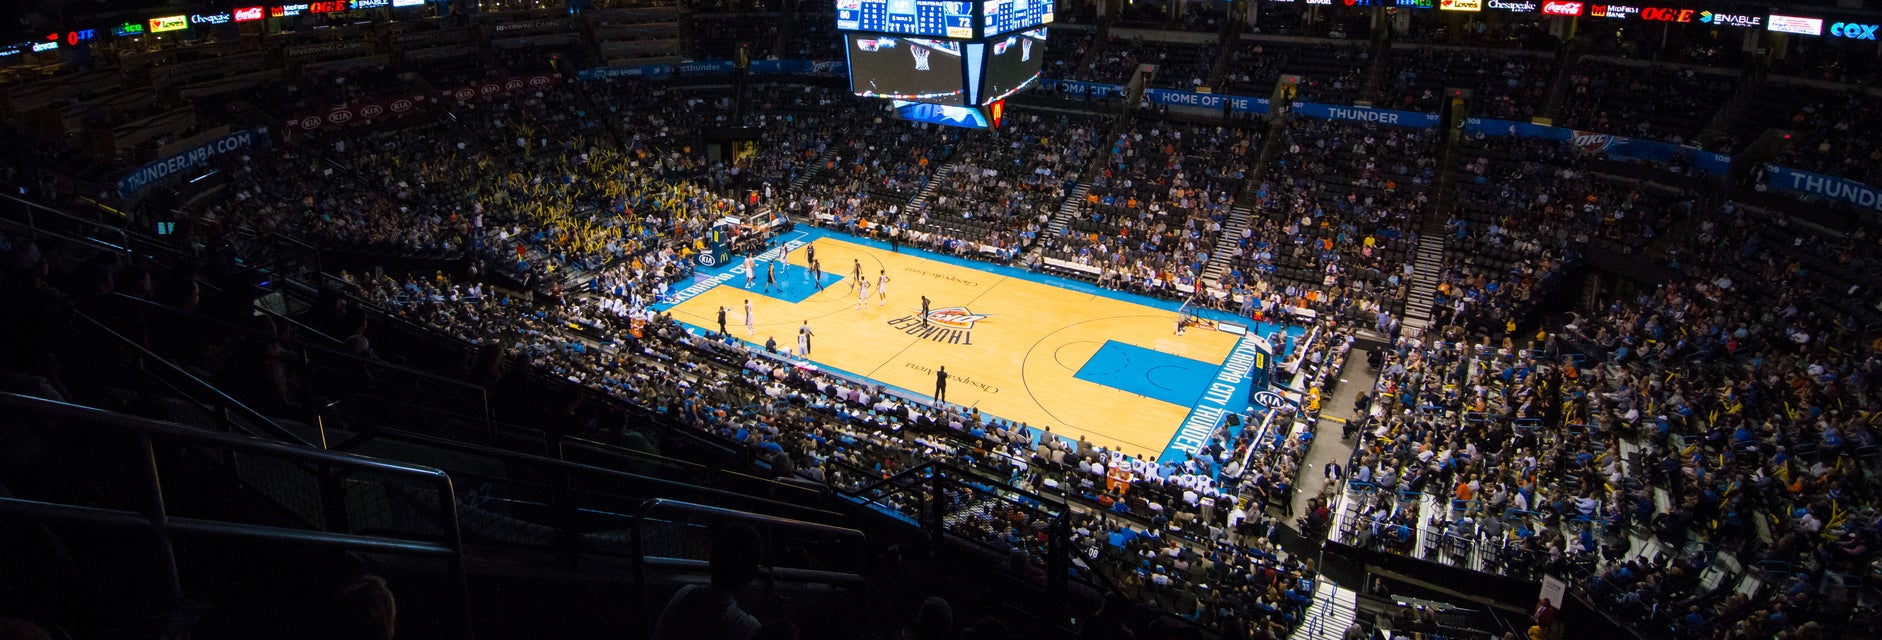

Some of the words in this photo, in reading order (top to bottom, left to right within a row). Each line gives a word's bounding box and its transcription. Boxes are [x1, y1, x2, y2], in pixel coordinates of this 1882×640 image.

[1488, 0, 1536, 10] Chesapeake
[840, 10, 850, 19] 80
[1713, 13, 1760, 25] ENABLE
[958, 17, 970, 27] 72
[1831, 21, 1879, 40] COX
[1162, 92, 1198, 105] HOME
[1201, 95, 1219, 106] OF
[1328, 107, 1398, 124] THUNDER
[1575, 134, 1606, 147] OKC
[1203, 382, 1235, 406] CITY
[1258, 393, 1281, 408] KIA
[1171, 404, 1223, 454] THUNDER
